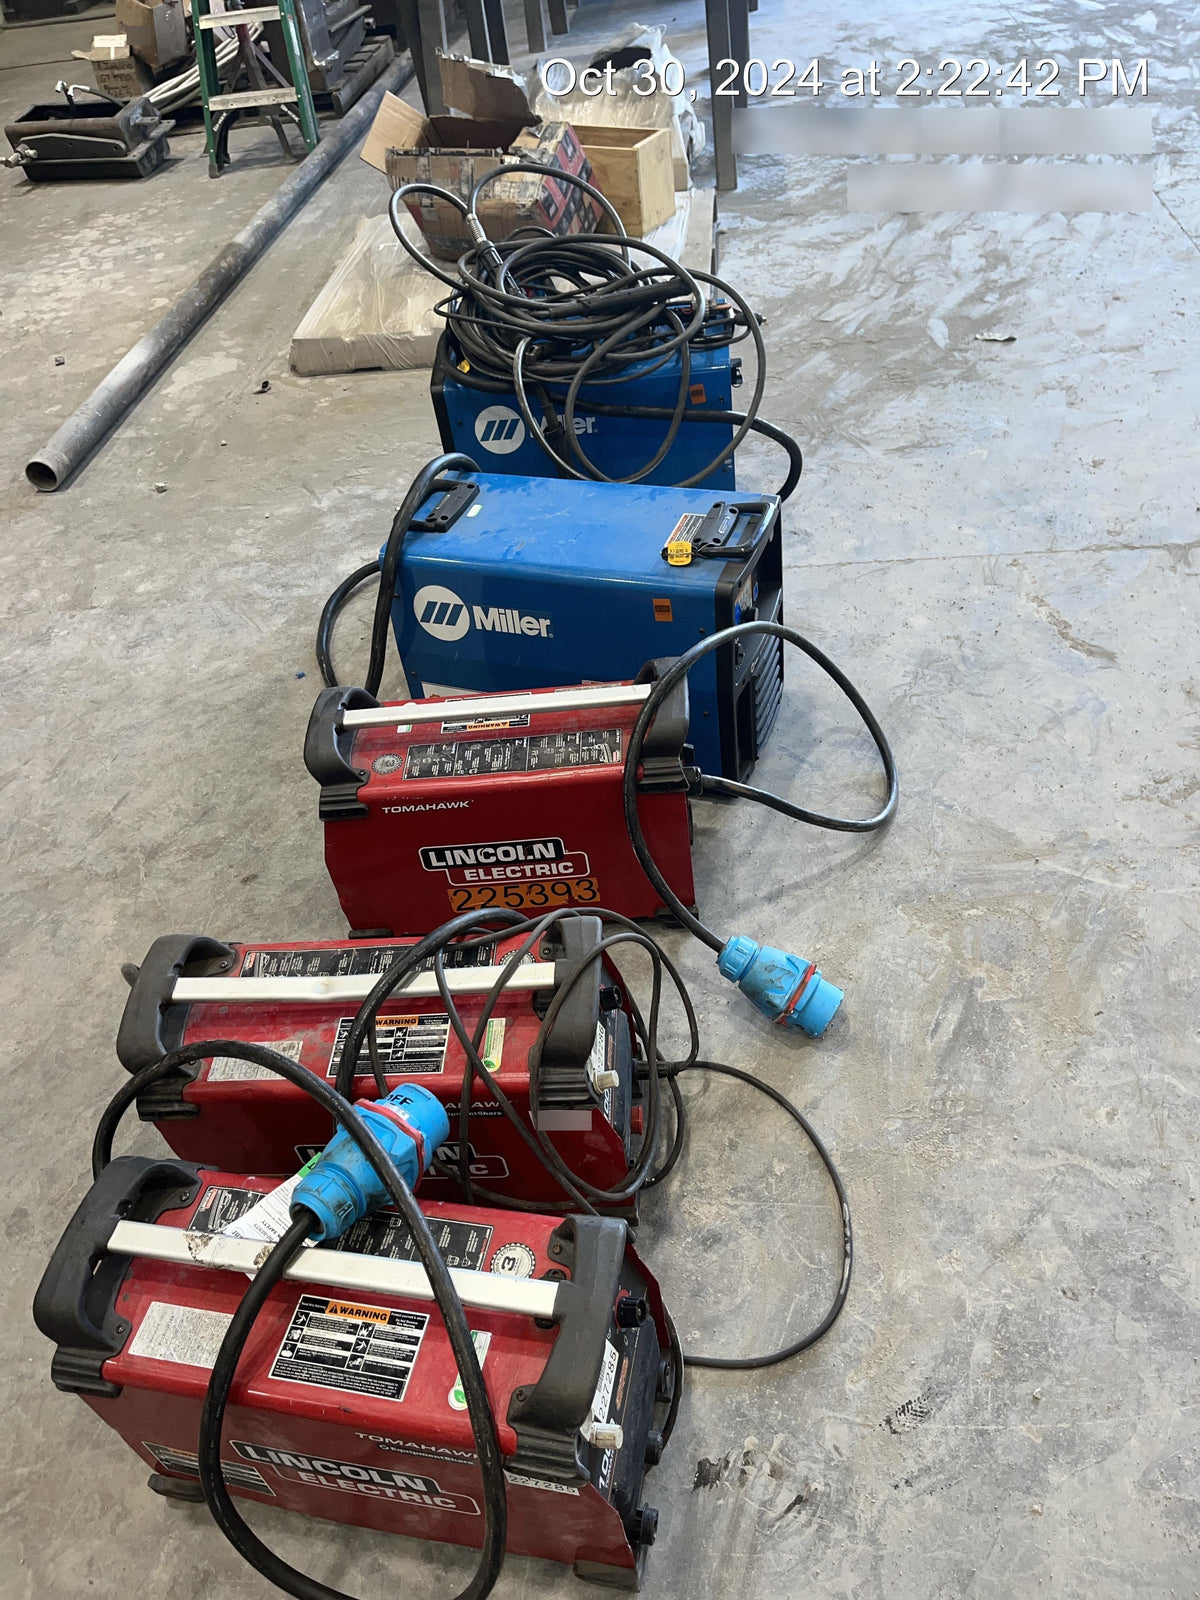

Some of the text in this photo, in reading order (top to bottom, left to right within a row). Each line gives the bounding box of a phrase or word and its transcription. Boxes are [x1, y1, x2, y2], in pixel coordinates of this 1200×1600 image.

[472, 604, 551, 638] Miller
[382, 800, 470, 814] TOMAHAWK
[428, 842, 557, 867] LINCOLN
[463, 861, 575, 881] ELECTRIC
[451, 878, 598, 912] 225393
[501, 1255, 516, 1272] 3
[339, 1306, 388, 1321] WARNING
[599, 1349, 617, 1421] 227285
[245, 1445, 428, 1492] LINCOLN
[297, 1470, 457, 1509] ELECTRIC
